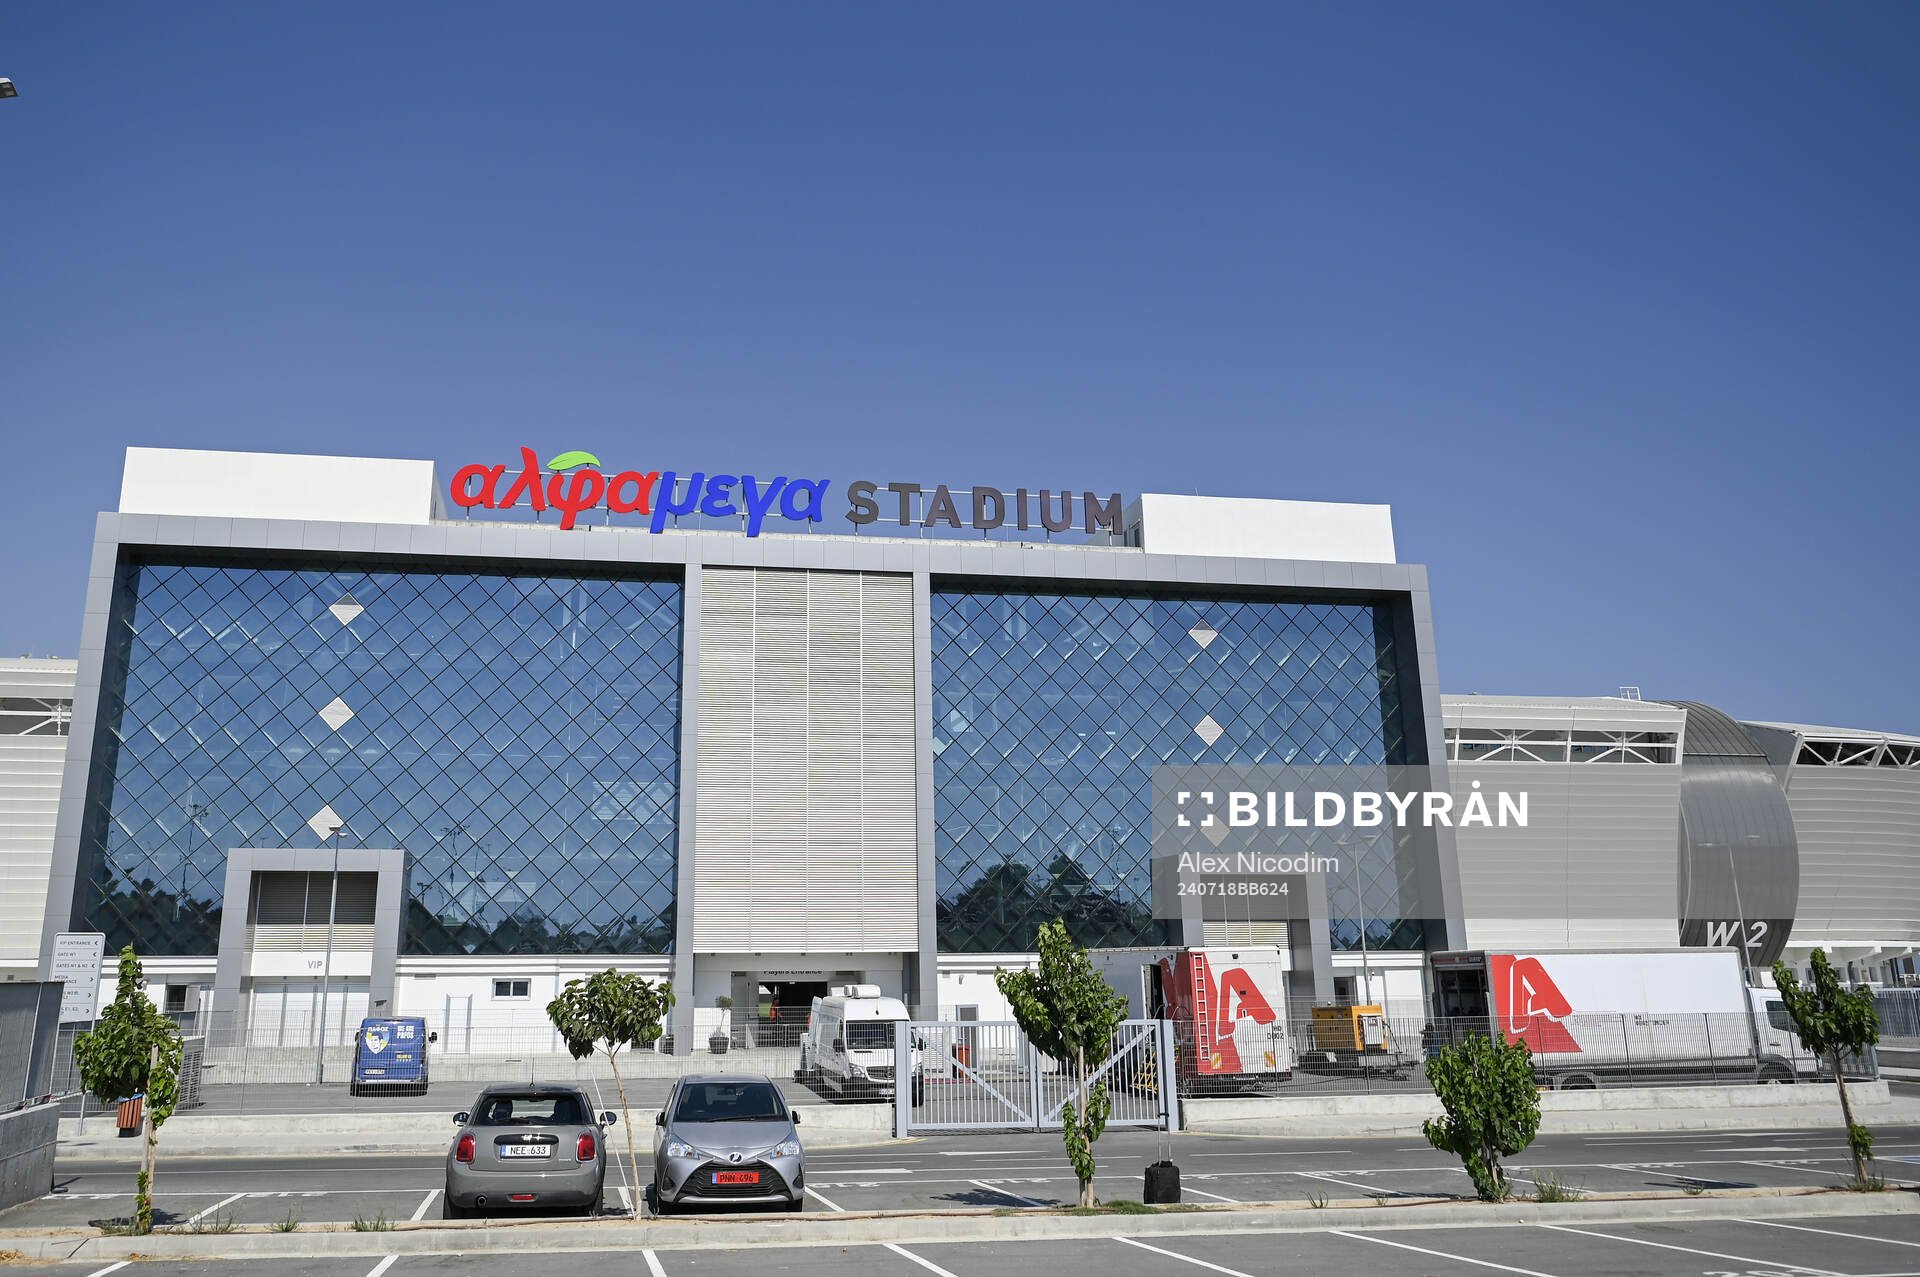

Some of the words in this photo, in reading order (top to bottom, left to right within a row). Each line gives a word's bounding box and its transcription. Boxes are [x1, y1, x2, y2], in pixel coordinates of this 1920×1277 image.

[450, 446, 830, 538] αλφαμεγα
[845, 480, 1124, 536] STADIUM
[307, 959, 323, 969] VIP
[510, 1146, 527, 1155] NEE
[530, 1146, 546, 1155] 633
